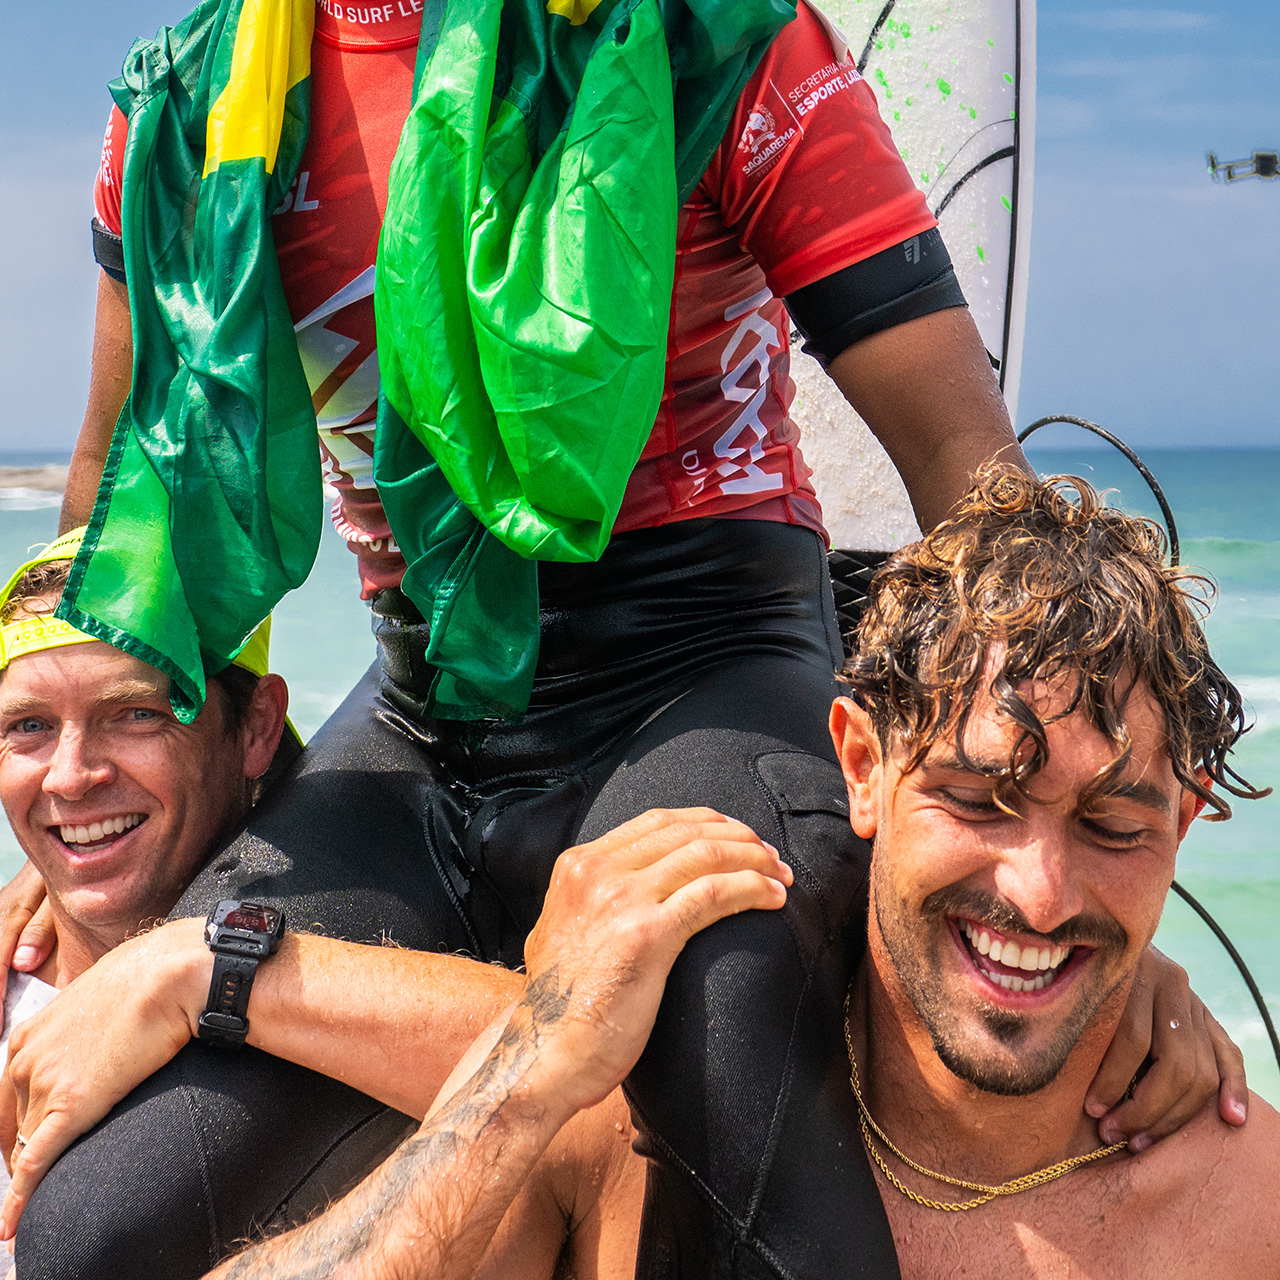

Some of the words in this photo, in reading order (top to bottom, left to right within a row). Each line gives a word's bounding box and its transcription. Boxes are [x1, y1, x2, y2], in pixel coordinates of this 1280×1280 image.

[346, 4, 394, 24] SURF
[787, 62, 839, 104] SECRETARIA
[742, 127, 796, 175] SAQUAREMA
